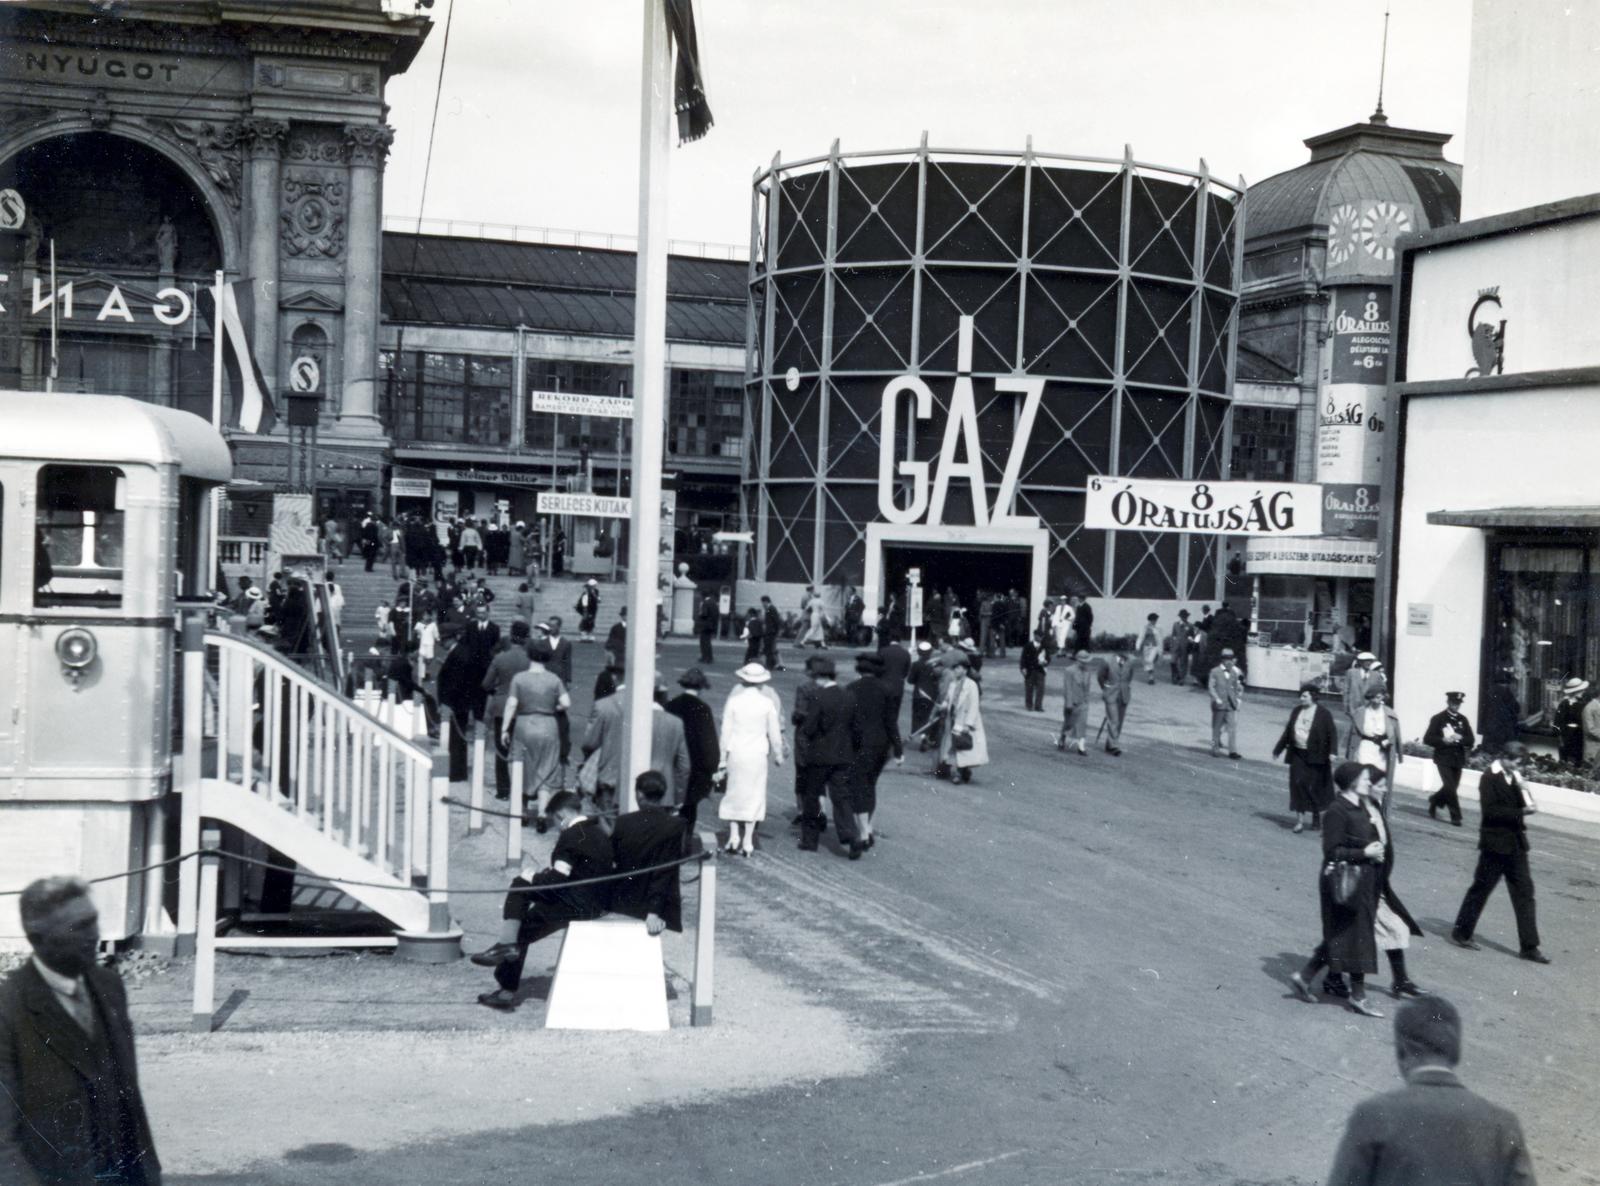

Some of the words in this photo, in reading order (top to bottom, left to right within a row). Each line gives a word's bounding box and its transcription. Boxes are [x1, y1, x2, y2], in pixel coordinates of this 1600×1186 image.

[26, 52, 179, 82] NYUGOT
[1363, 355, 1375, 369] 6
[878, 315, 1045, 528] GÁZ
[1091, 478, 1102, 491] 6
[594, 499, 629, 514] KUTAK
[1191, 484, 1214, 510] 8
[1355, 488, 1369, 507] 8
